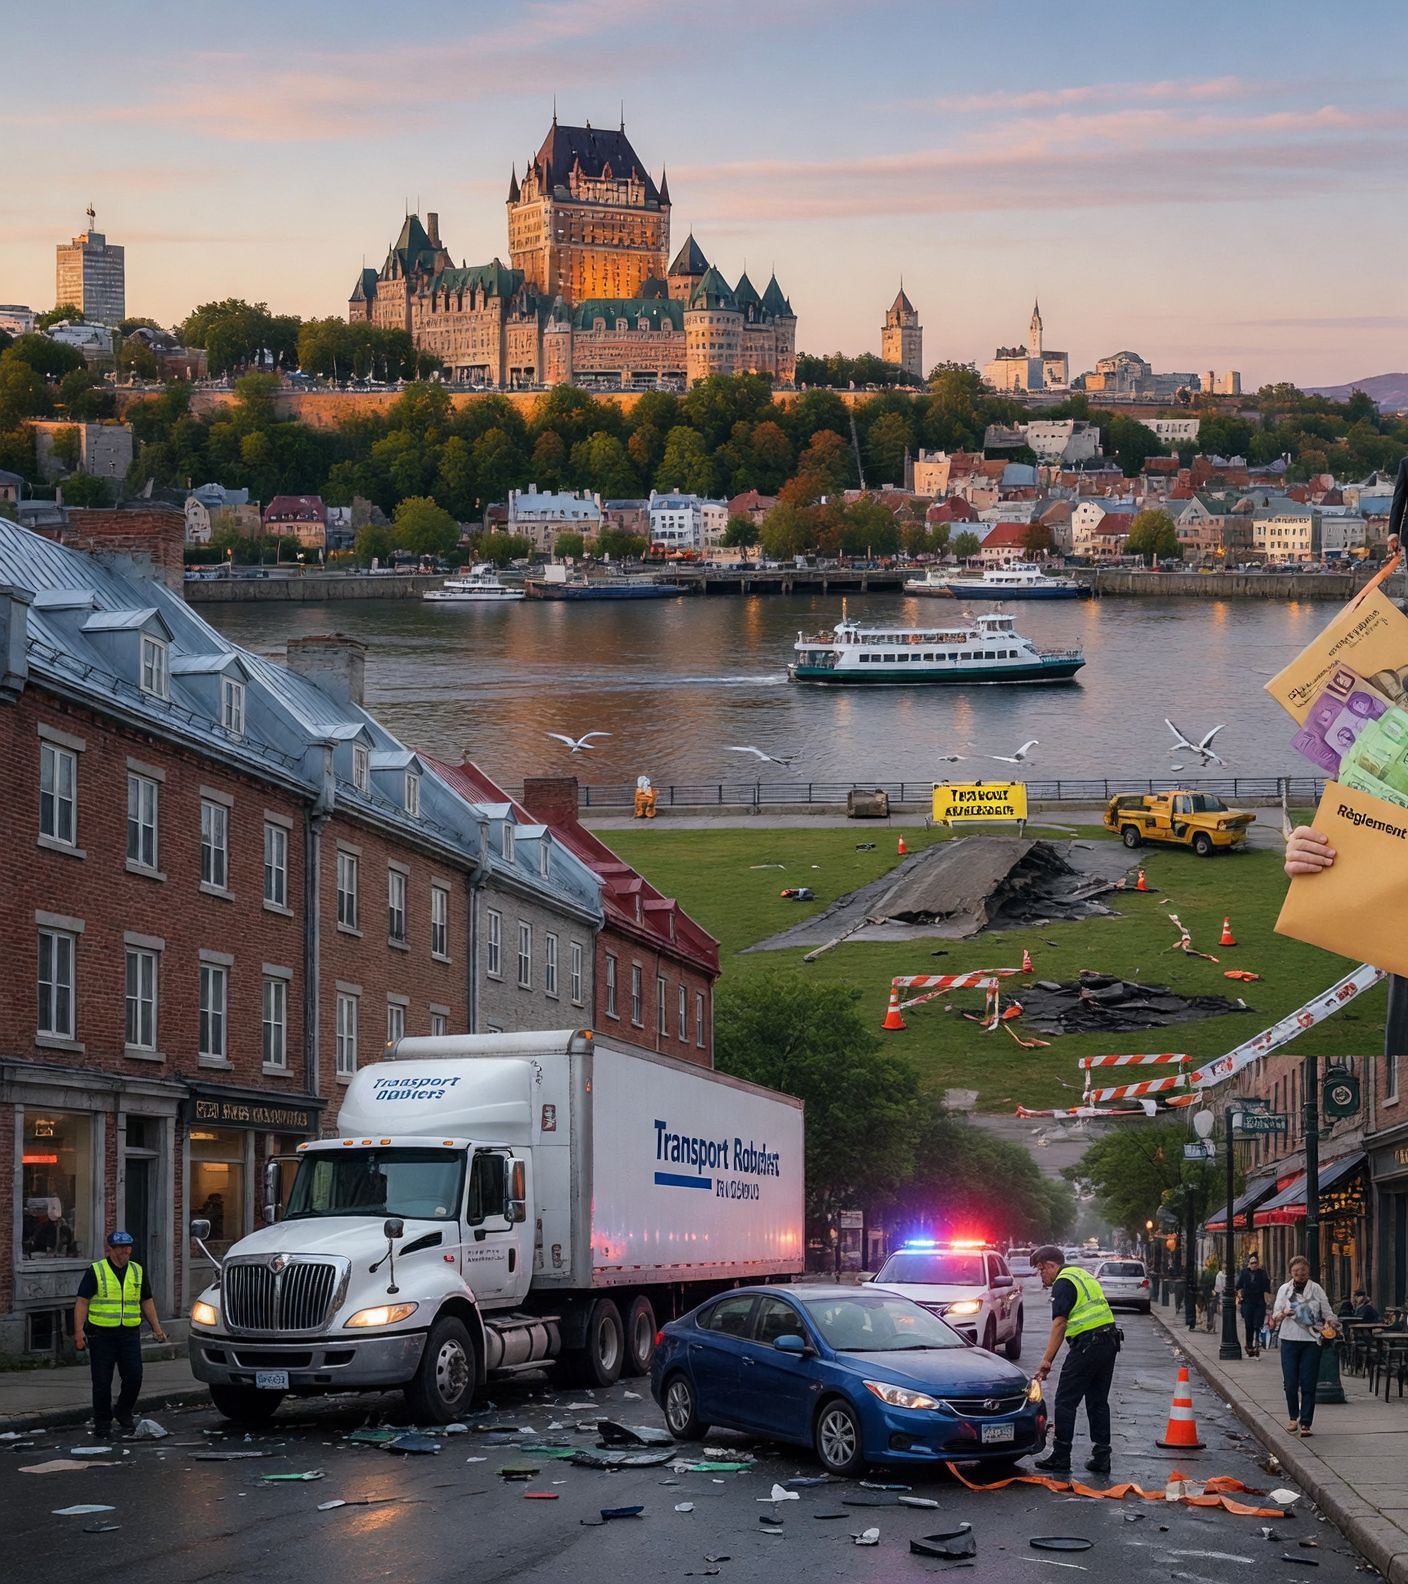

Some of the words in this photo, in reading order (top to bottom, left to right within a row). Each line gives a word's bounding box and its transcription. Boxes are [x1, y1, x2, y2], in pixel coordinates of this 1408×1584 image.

[1336, 804, 1408, 840] Règlement
[373, 1077, 461, 1089] Transport
[654, 1119, 729, 1175] Transport
